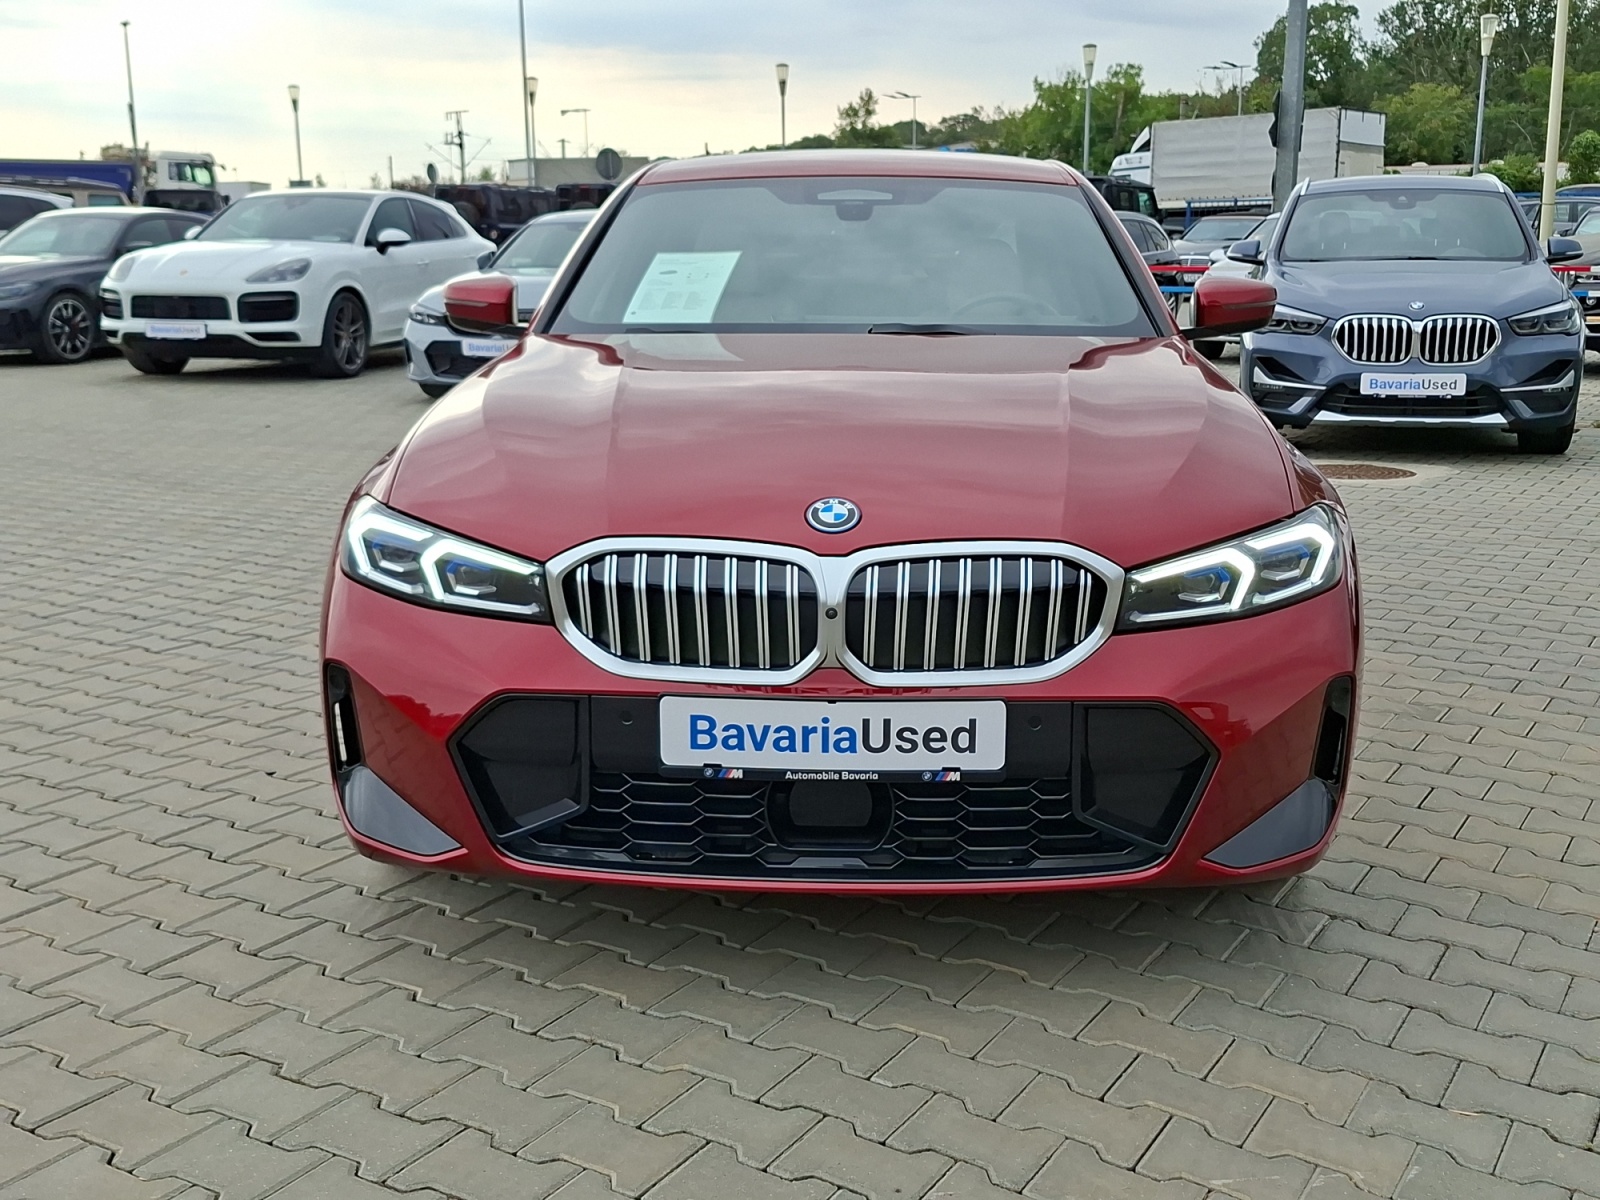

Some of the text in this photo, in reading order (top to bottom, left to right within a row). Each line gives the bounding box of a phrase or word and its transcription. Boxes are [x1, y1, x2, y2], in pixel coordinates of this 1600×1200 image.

[1369, 378, 1458, 390] BavariaUsed
[689, 713, 978, 755] BavariaUsed
[785, 771, 879, 780] Automobile Bavaria
